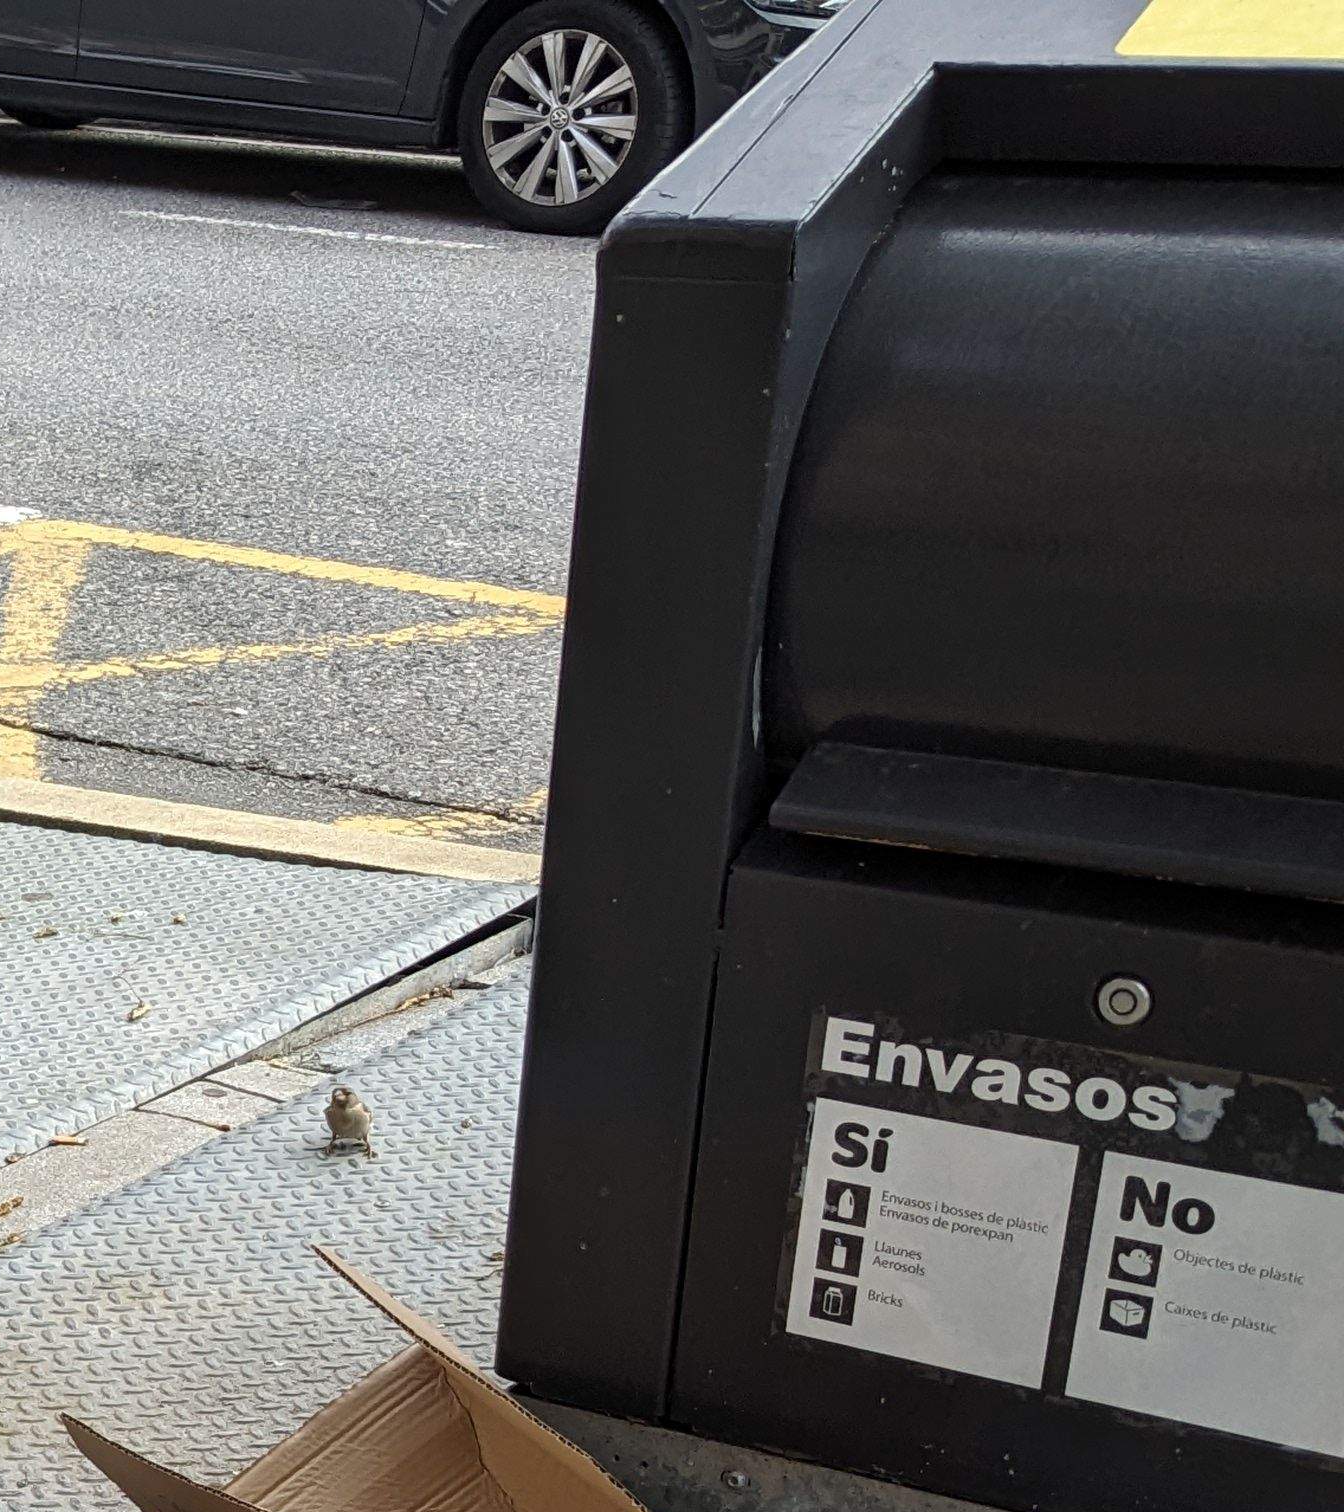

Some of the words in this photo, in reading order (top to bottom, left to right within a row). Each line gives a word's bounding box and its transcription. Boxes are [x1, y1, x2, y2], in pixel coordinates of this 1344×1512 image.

[820, 1016, 1180, 1133] Envasos
[830, 1121, 896, 1175] Sí
[881, 1189, 932, 1212] Envasos
[940, 1202, 984, 1222] bosses
[986, 1211, 1004, 1226] de
[1118, 1174, 1217, 1236] No
[879, 1205, 930, 1226] Envasos
[931, 1216, 950, 1230] de
[950, 1221, 1014, 1243] porexpan
[871, 1255, 926, 1277] Aerosols
[874, 1240, 923, 1261] Llaunes
[1173, 1248, 1235, 1271] Objectes
[1237, 1262, 1256, 1276] de
[867, 1288, 904, 1309] Bricks
[1164, 1300, 1208, 1321] Caixes
[1210, 1311, 1229, 1325] de
